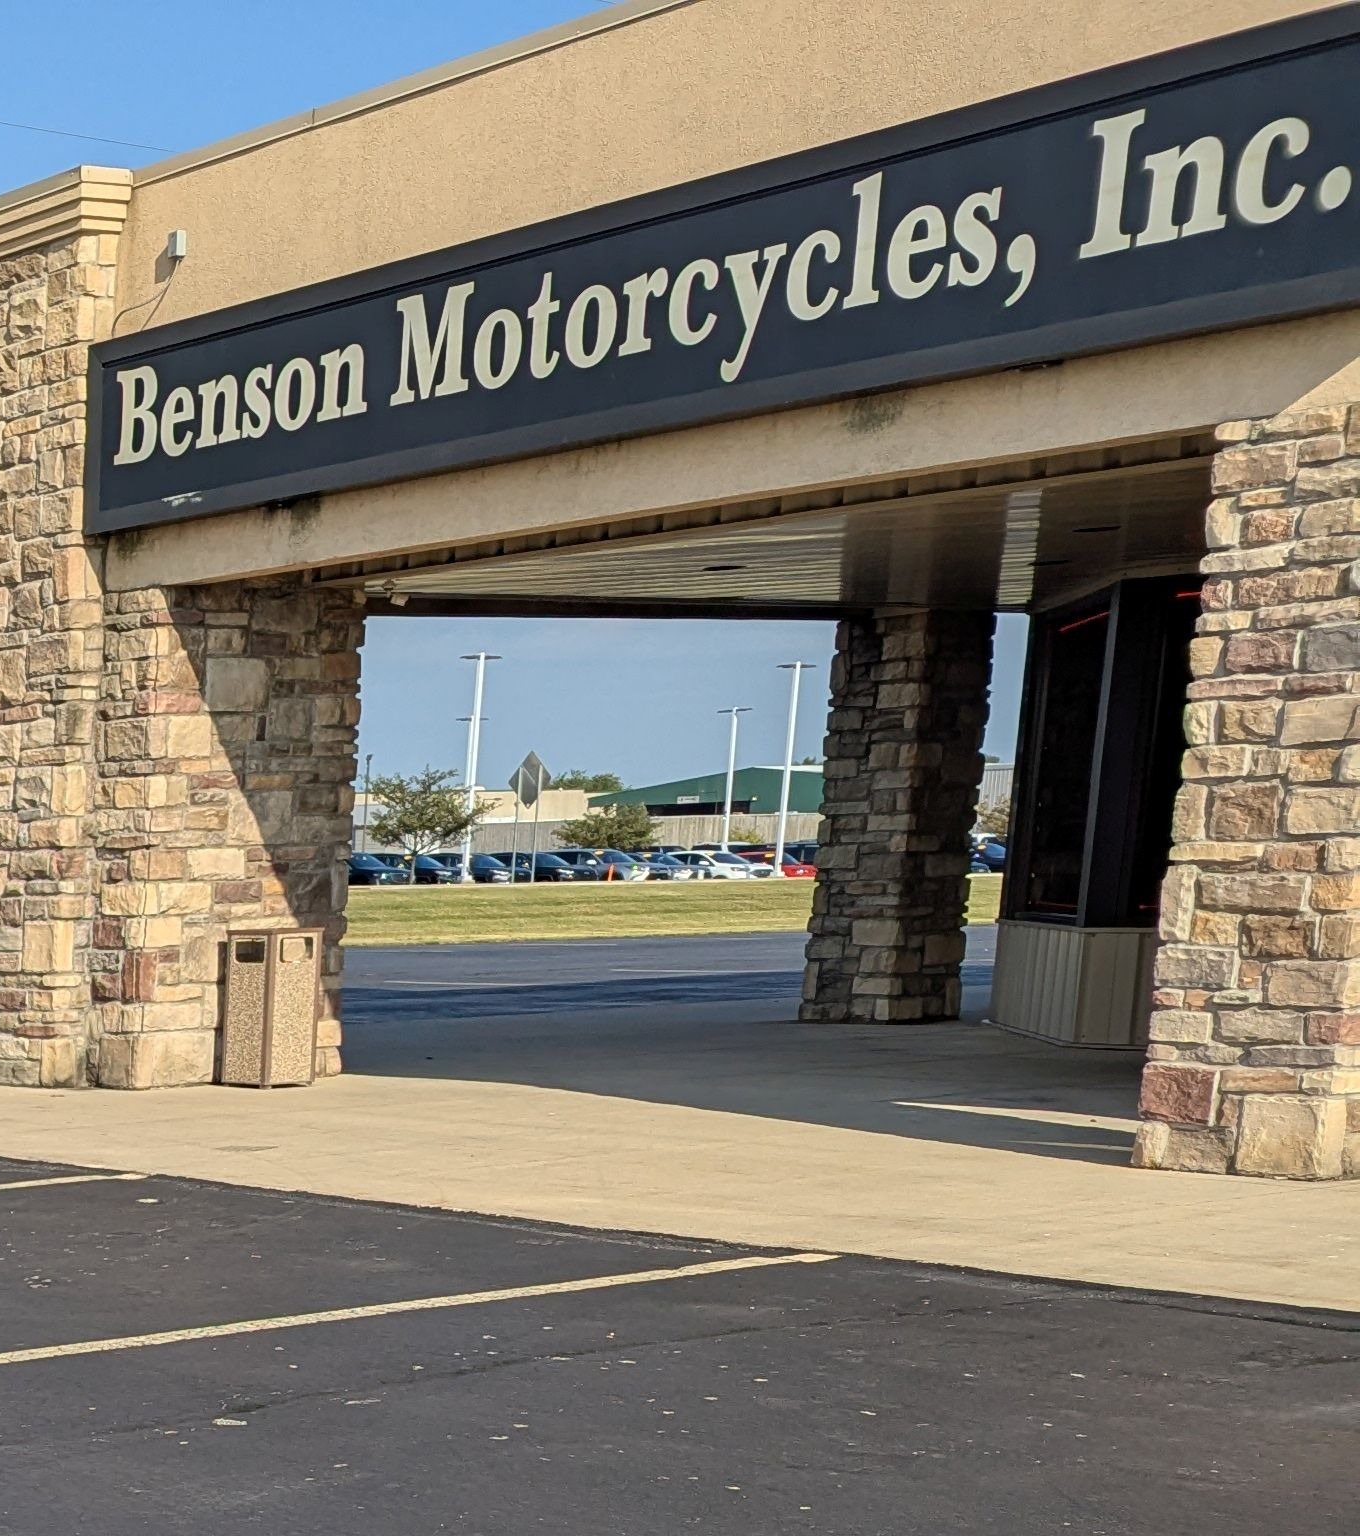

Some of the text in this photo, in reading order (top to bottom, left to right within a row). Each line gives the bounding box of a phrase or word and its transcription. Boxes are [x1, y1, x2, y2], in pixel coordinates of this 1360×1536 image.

[113, 108, 1353, 466] Benson Motorcycles, Inc.
